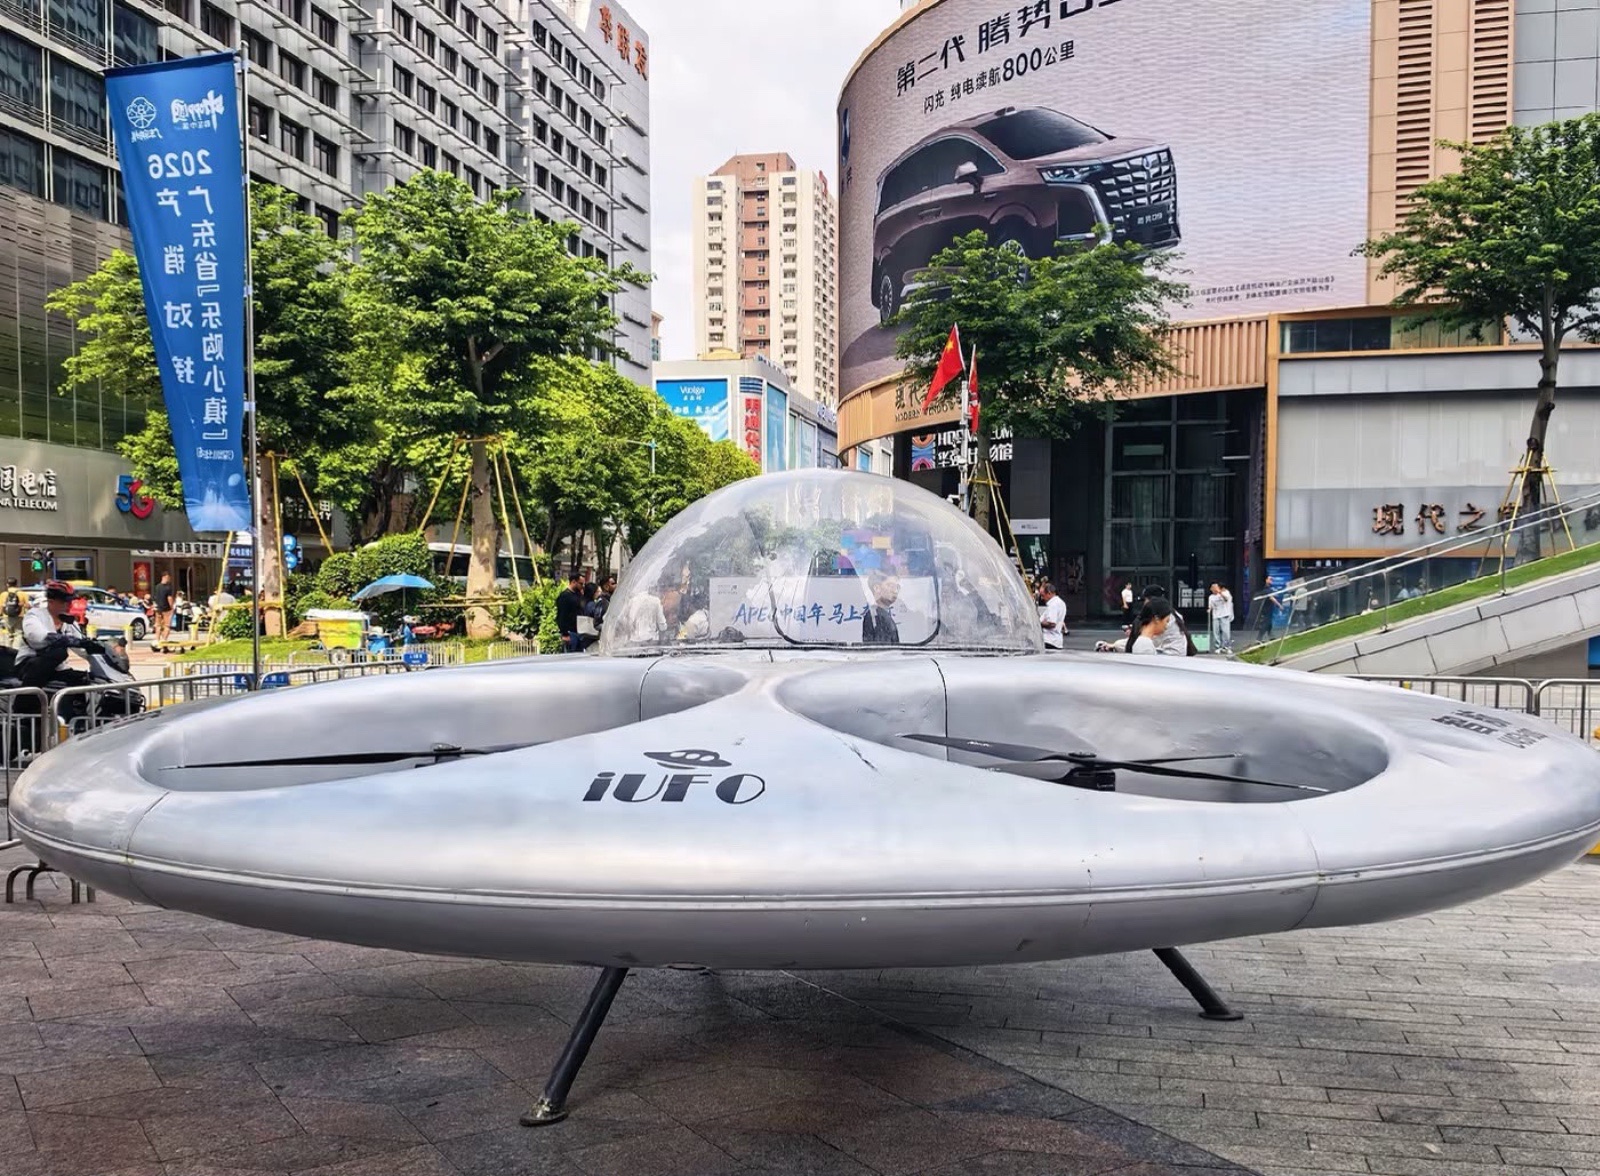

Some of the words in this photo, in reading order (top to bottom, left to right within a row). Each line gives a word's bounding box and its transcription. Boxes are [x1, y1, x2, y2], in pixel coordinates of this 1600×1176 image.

[897, 35, 965, 97] 第二代
[978, 0, 1122, 54] 腾势D
[923, 89, 945, 114] 闪充
[950, 40, 1075, 102] 纯电续航800公里
[13, 498, 58, 511] TELECOM
[115, 475, 155, 519] 5G
[582, 771, 766, 805] iUFO
